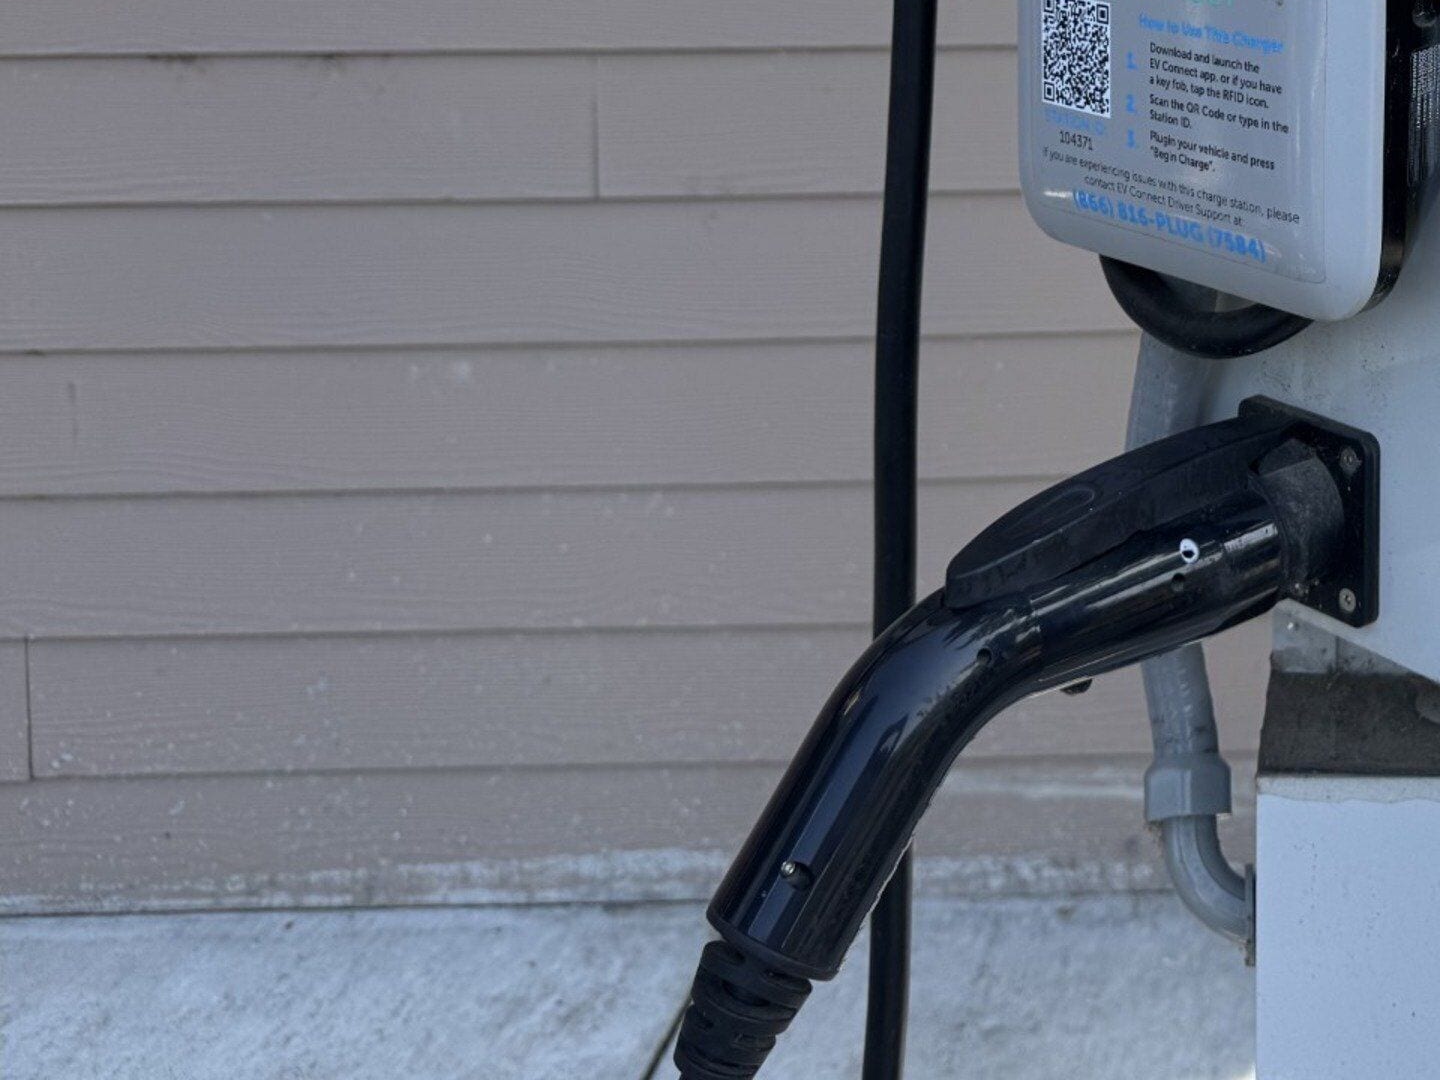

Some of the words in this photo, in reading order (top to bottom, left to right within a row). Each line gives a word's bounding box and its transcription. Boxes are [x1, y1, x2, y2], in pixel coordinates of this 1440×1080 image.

[1150, 41, 1192, 61] Download
[1194, 52, 1210, 64] and
[1212, 53, 1242, 70] launch
[1244, 61, 1261, 74] the
[1150, 58, 1160, 69] EV
[1162, 61, 1198, 78] Connect
[1220, 75, 1230, 84] or
[1240, 78, 1257, 90] you
[1259, 80, 1283, 95] have
[1156, 76, 1170, 90] key
[1190, 85, 1205, 97] tap
[1207, 87, 1222, 99] the
[1223, 90, 1245, 103] RFID
[1149, 93, 1169, 108] Scan
[1170, 98, 1185, 111] the
[1186, 101, 1200, 115] QR
[1201, 106, 1224, 121] Code
[1226, 113, 1237, 122] or
[1239, 114, 1259, 129] type
[1261, 118, 1270, 130] in
[1272, 120, 1290, 134] the
[1149, 109, 1179, 125] Station
[1059, 129, 1094, 151] 104371
[1150, 130, 1176, 147] Plugin
[1177, 138, 1197, 151] your
[1199, 141, 1229, 160] vehicle
[1231, 152, 1248, 164] and
[1250, 155, 1275, 170] press
[1049, 150, 1064, 162] you
[1065, 155, 1078, 166] are
[1079, 158, 1130, 181] experiencing
[1132, 172, 1157, 187] issues
[1158, 178, 1177, 192] with
[1178, 182, 1195, 195] this
[1196, 188, 1228, 207] charge
[1267, 207, 1300, 224] please
[1084, 175, 1115, 192] contact
[1117, 182, 1128, 194] EV
[1129, 185, 1166, 206] Connect
[1168, 196, 1193, 213] Driver
[1195, 202, 1231, 223] Support
[1073, 188, 1114, 217] (866)
[1117, 197, 1204, 243] 816-PLUG
[1208, 224, 1267, 264] (7584)
